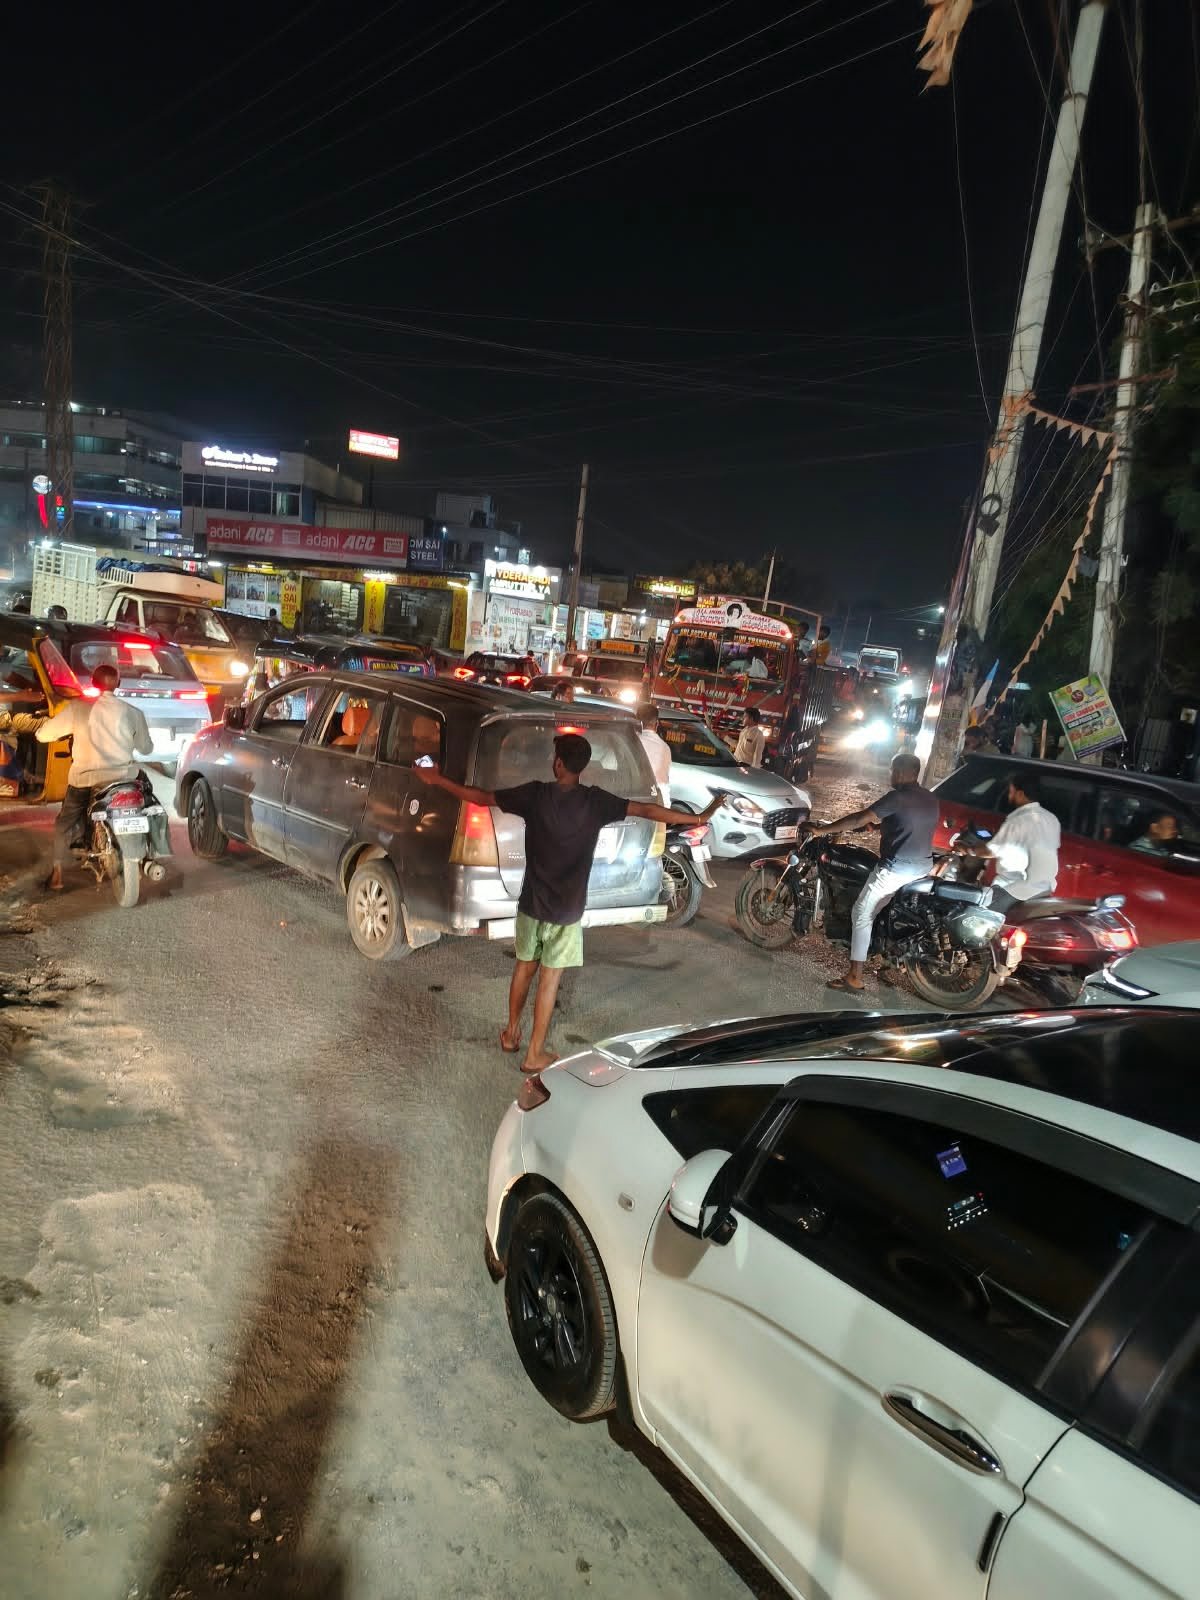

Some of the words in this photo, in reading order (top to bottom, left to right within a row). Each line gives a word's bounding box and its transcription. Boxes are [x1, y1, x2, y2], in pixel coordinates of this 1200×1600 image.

[210, 524, 240, 539] adani
[244, 527, 275, 542] ACC
[306, 532, 339, 547] adani
[343, 535, 376, 551] ACC
[409, 539, 423, 549] OM
[425, 541, 440, 550] SAI
[410, 551, 438, 561] STEEL
[284, 583, 297, 592] OM
[284, 593, 297, 603] SAI
